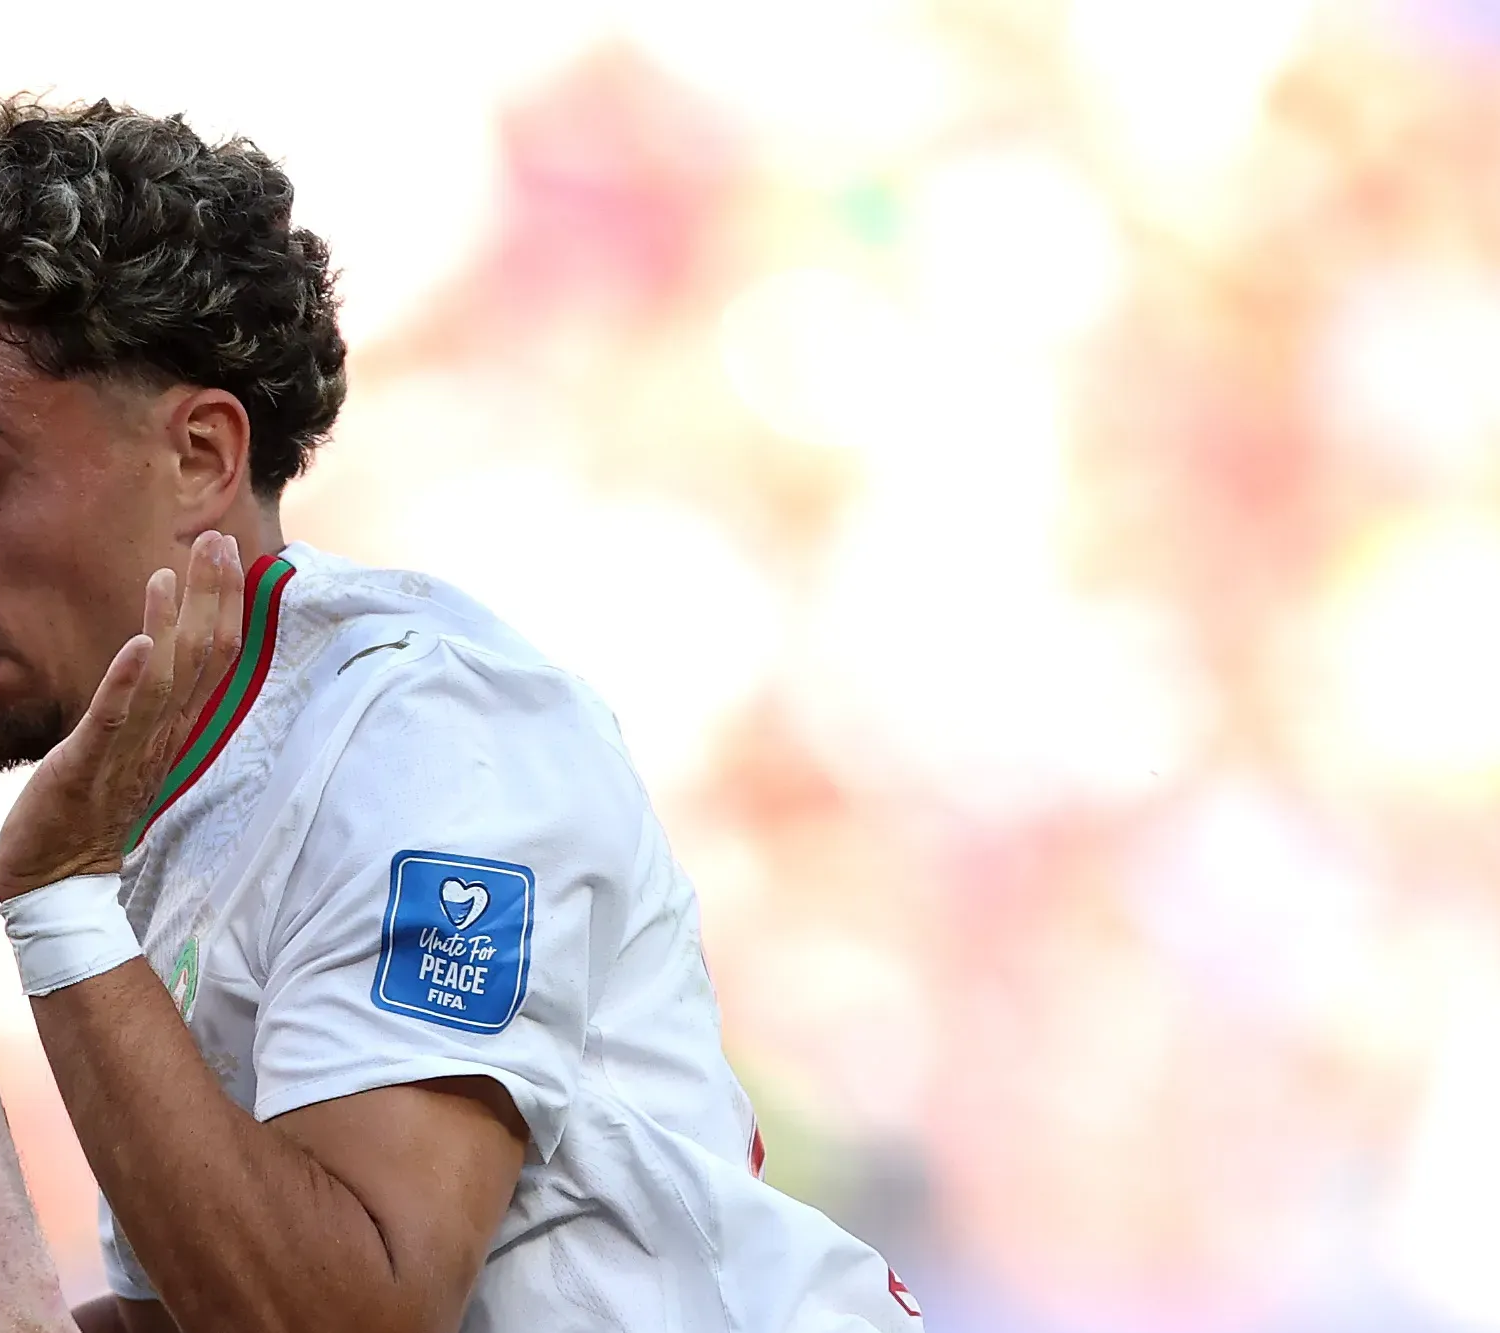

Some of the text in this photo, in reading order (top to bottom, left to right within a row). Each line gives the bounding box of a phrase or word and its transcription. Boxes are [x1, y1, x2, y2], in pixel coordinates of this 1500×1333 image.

[419, 927, 497, 963] Unite For
[419, 953, 488, 995] PEACE
[427, 988, 466, 1010] FIFA
